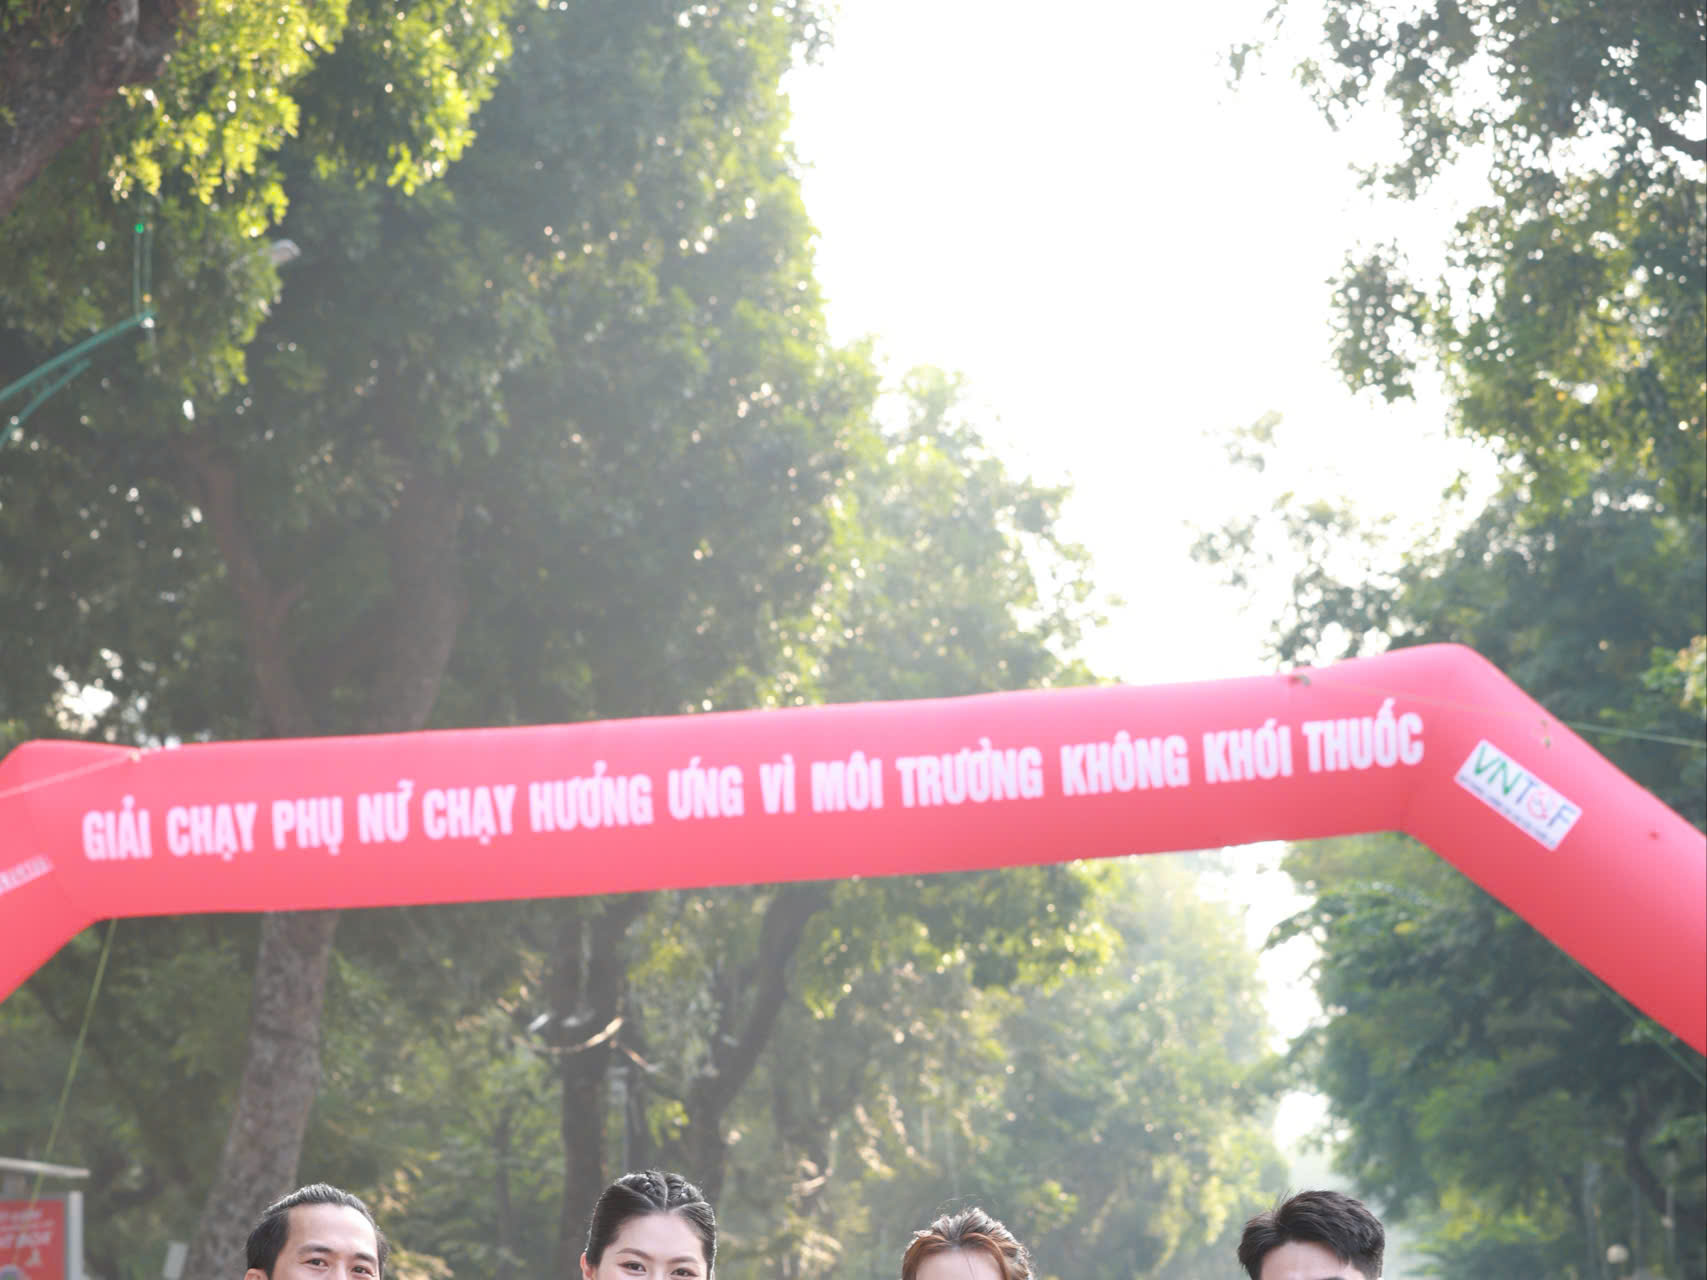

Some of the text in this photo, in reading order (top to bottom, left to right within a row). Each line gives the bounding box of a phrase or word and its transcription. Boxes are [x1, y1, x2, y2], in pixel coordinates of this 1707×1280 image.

[84, 698, 1422, 860] GIẢI CHẠY PHỤ NỮ CHẠY HƯỞNG ỨNG VÌ MÔI TRƯỜNG KHÔNG KHÓI THUỐC
